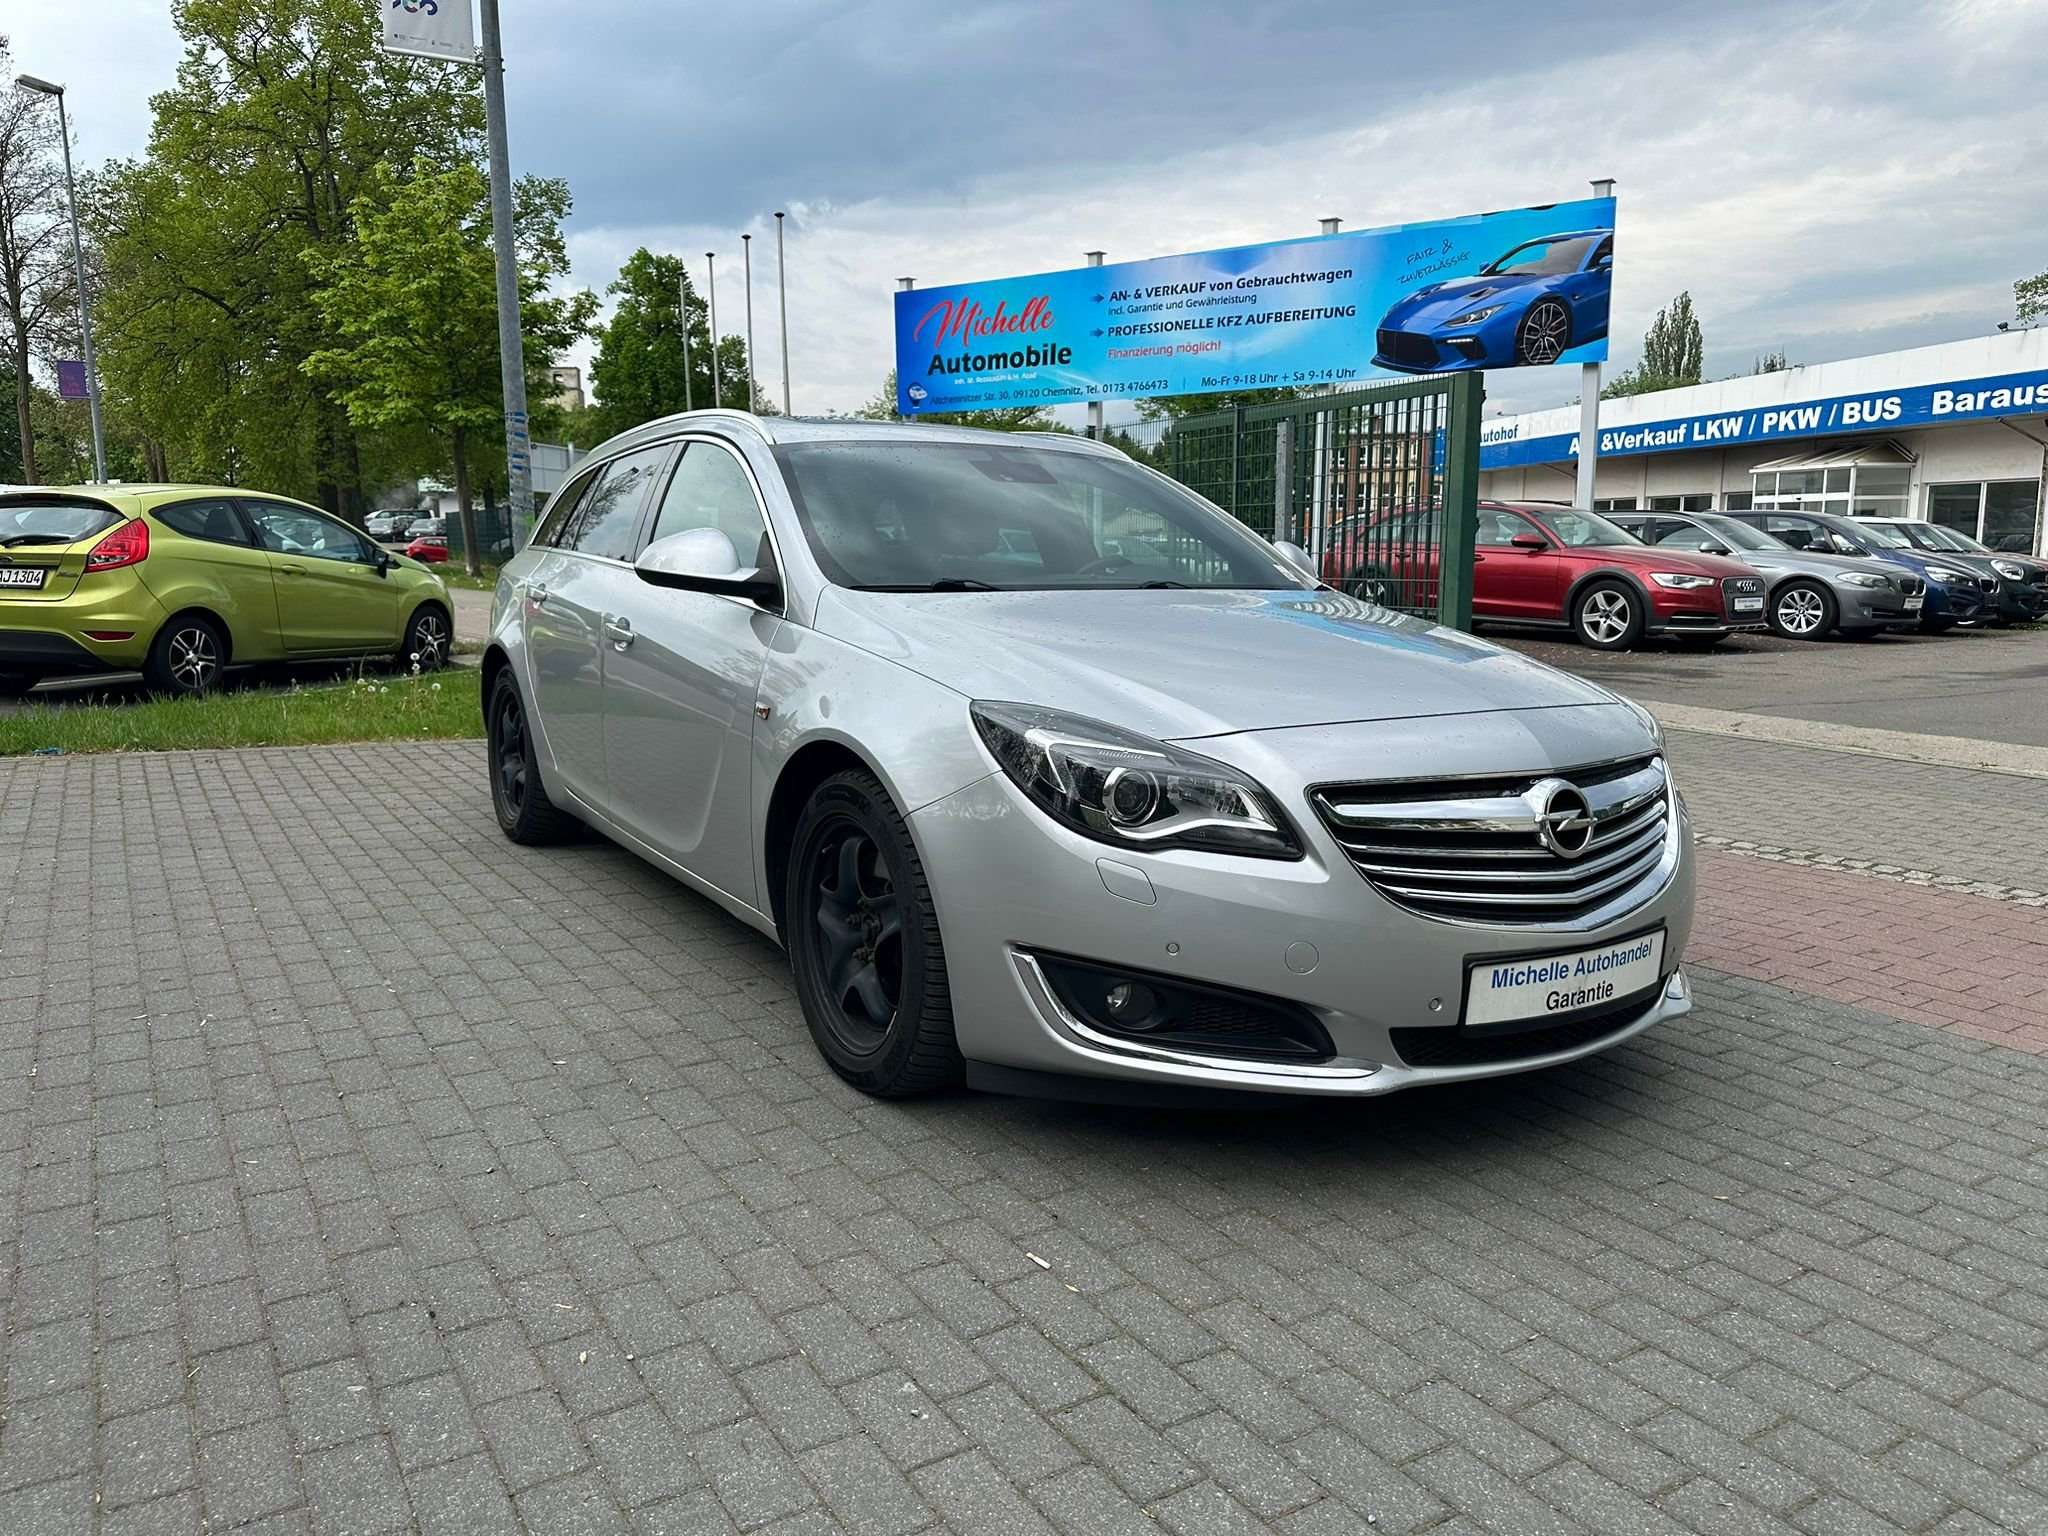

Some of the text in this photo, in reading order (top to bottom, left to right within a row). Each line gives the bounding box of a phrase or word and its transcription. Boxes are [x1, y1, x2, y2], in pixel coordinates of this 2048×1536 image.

[1109, 268, 1353, 302] AN- & VERKAUF von Gebrauchtwagen
[1127, 301, 1164, 315] Garantie
[1165, 300, 1184, 310] und
[1186, 294, 1257, 308] Gewährleistung
[913, 295, 1056, 349] Michelle
[1108, 305, 1357, 337] PROFESSIONELLE KFZ AUFBEREITUNG
[927, 343, 1073, 376] Automobile
[1108, 340, 1221, 359] Finanzierung möglich!
[1013, 387, 1040, 400] 09120
[1041, 386, 1083, 398] Chemnitz,
[1102, 382, 1125, 394] 0173
[1127, 379, 1168, 392] 4766473
[1201, 366, 1357, 387] Mo-Fr 9-18 Uhr + Sa 9-14 Uhr
[1481, 423, 1519, 443] utohof
[1692, 416, 1743, 441] LKW
[1748, 413, 1758, 436] /
[1762, 404, 1822, 434] PKW
[1827, 403, 1839, 427] /
[1842, 396, 1902, 425] BUS
[1491, 937, 1653, 989] Michelle Autohandel
[1545, 979, 1614, 1011] Garantie
